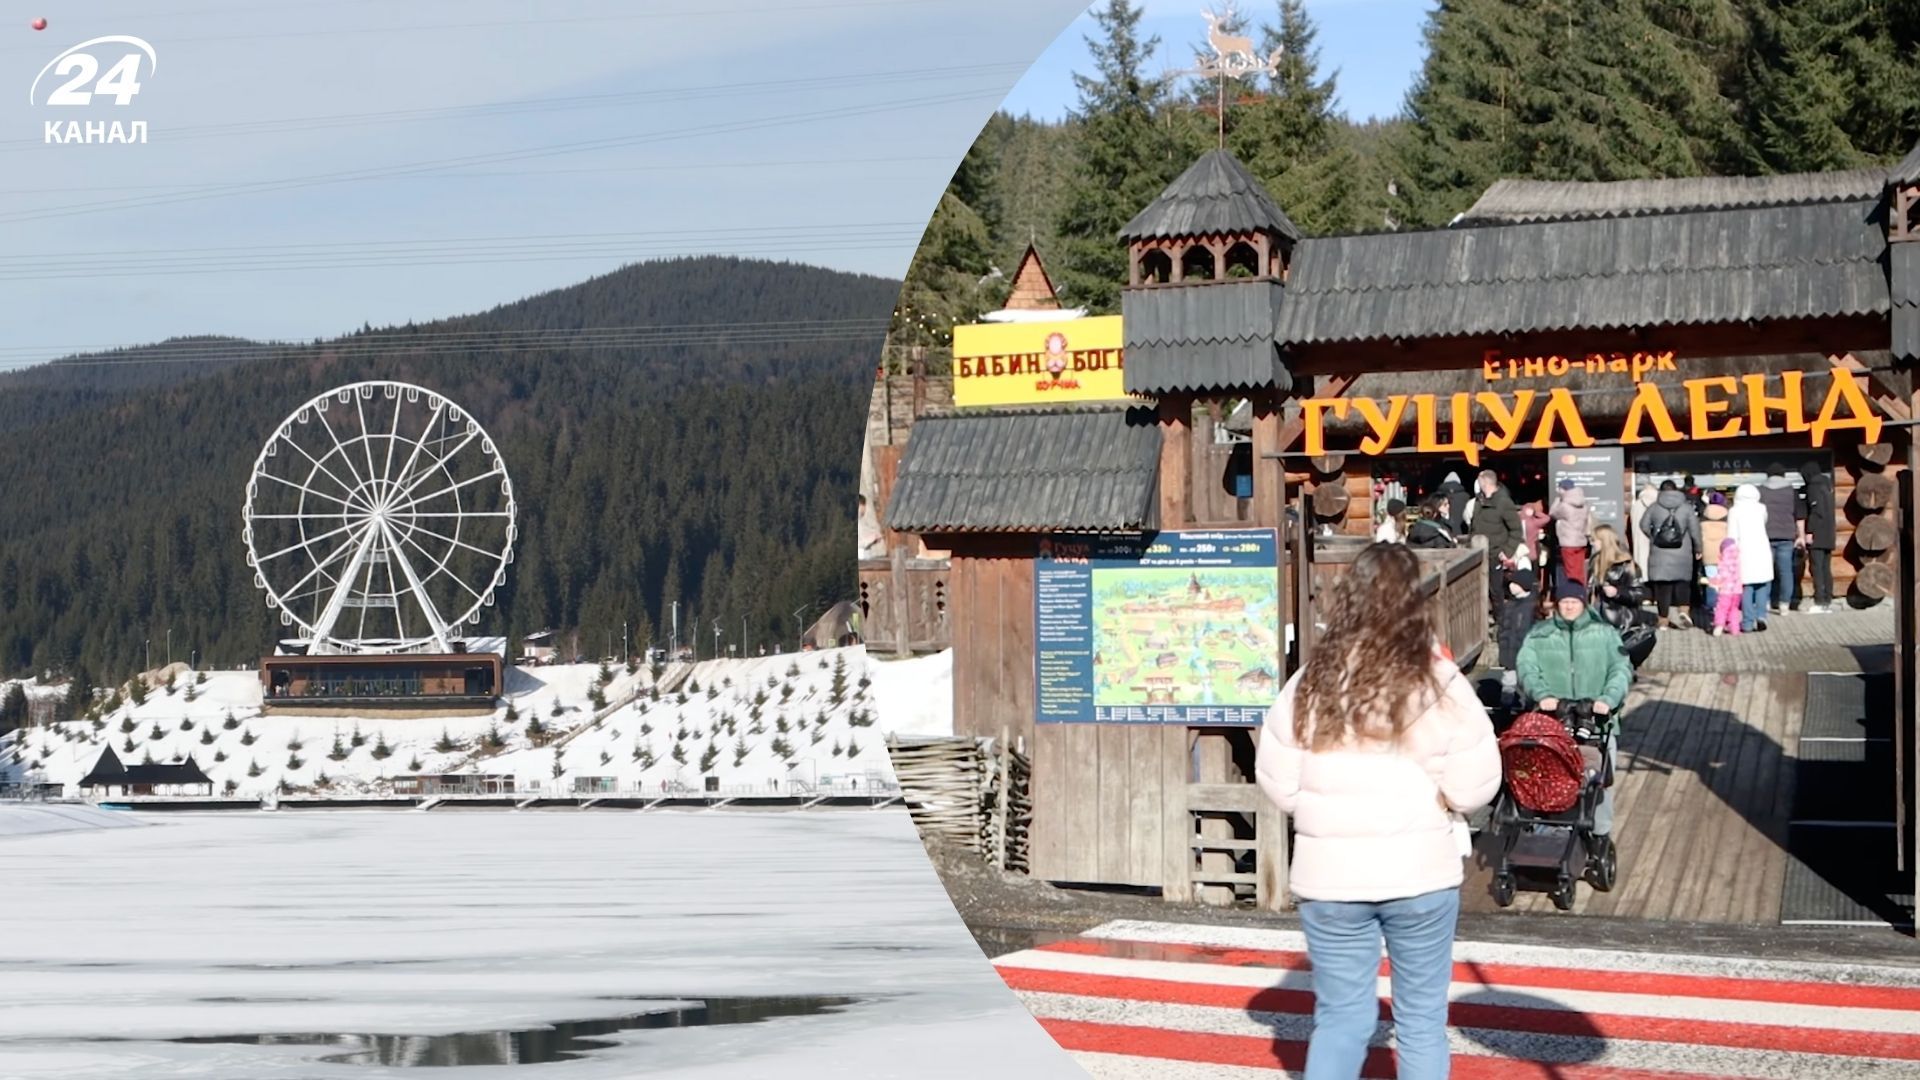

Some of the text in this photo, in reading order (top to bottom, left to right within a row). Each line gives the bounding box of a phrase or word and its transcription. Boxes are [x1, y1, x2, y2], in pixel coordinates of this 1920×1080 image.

[960, 353, 1041, 378] БАБИН
[1301, 366, 1883, 466] ГУЦУЛ ЛЕНД
[1712, 459, 1752, 469] КАСА
